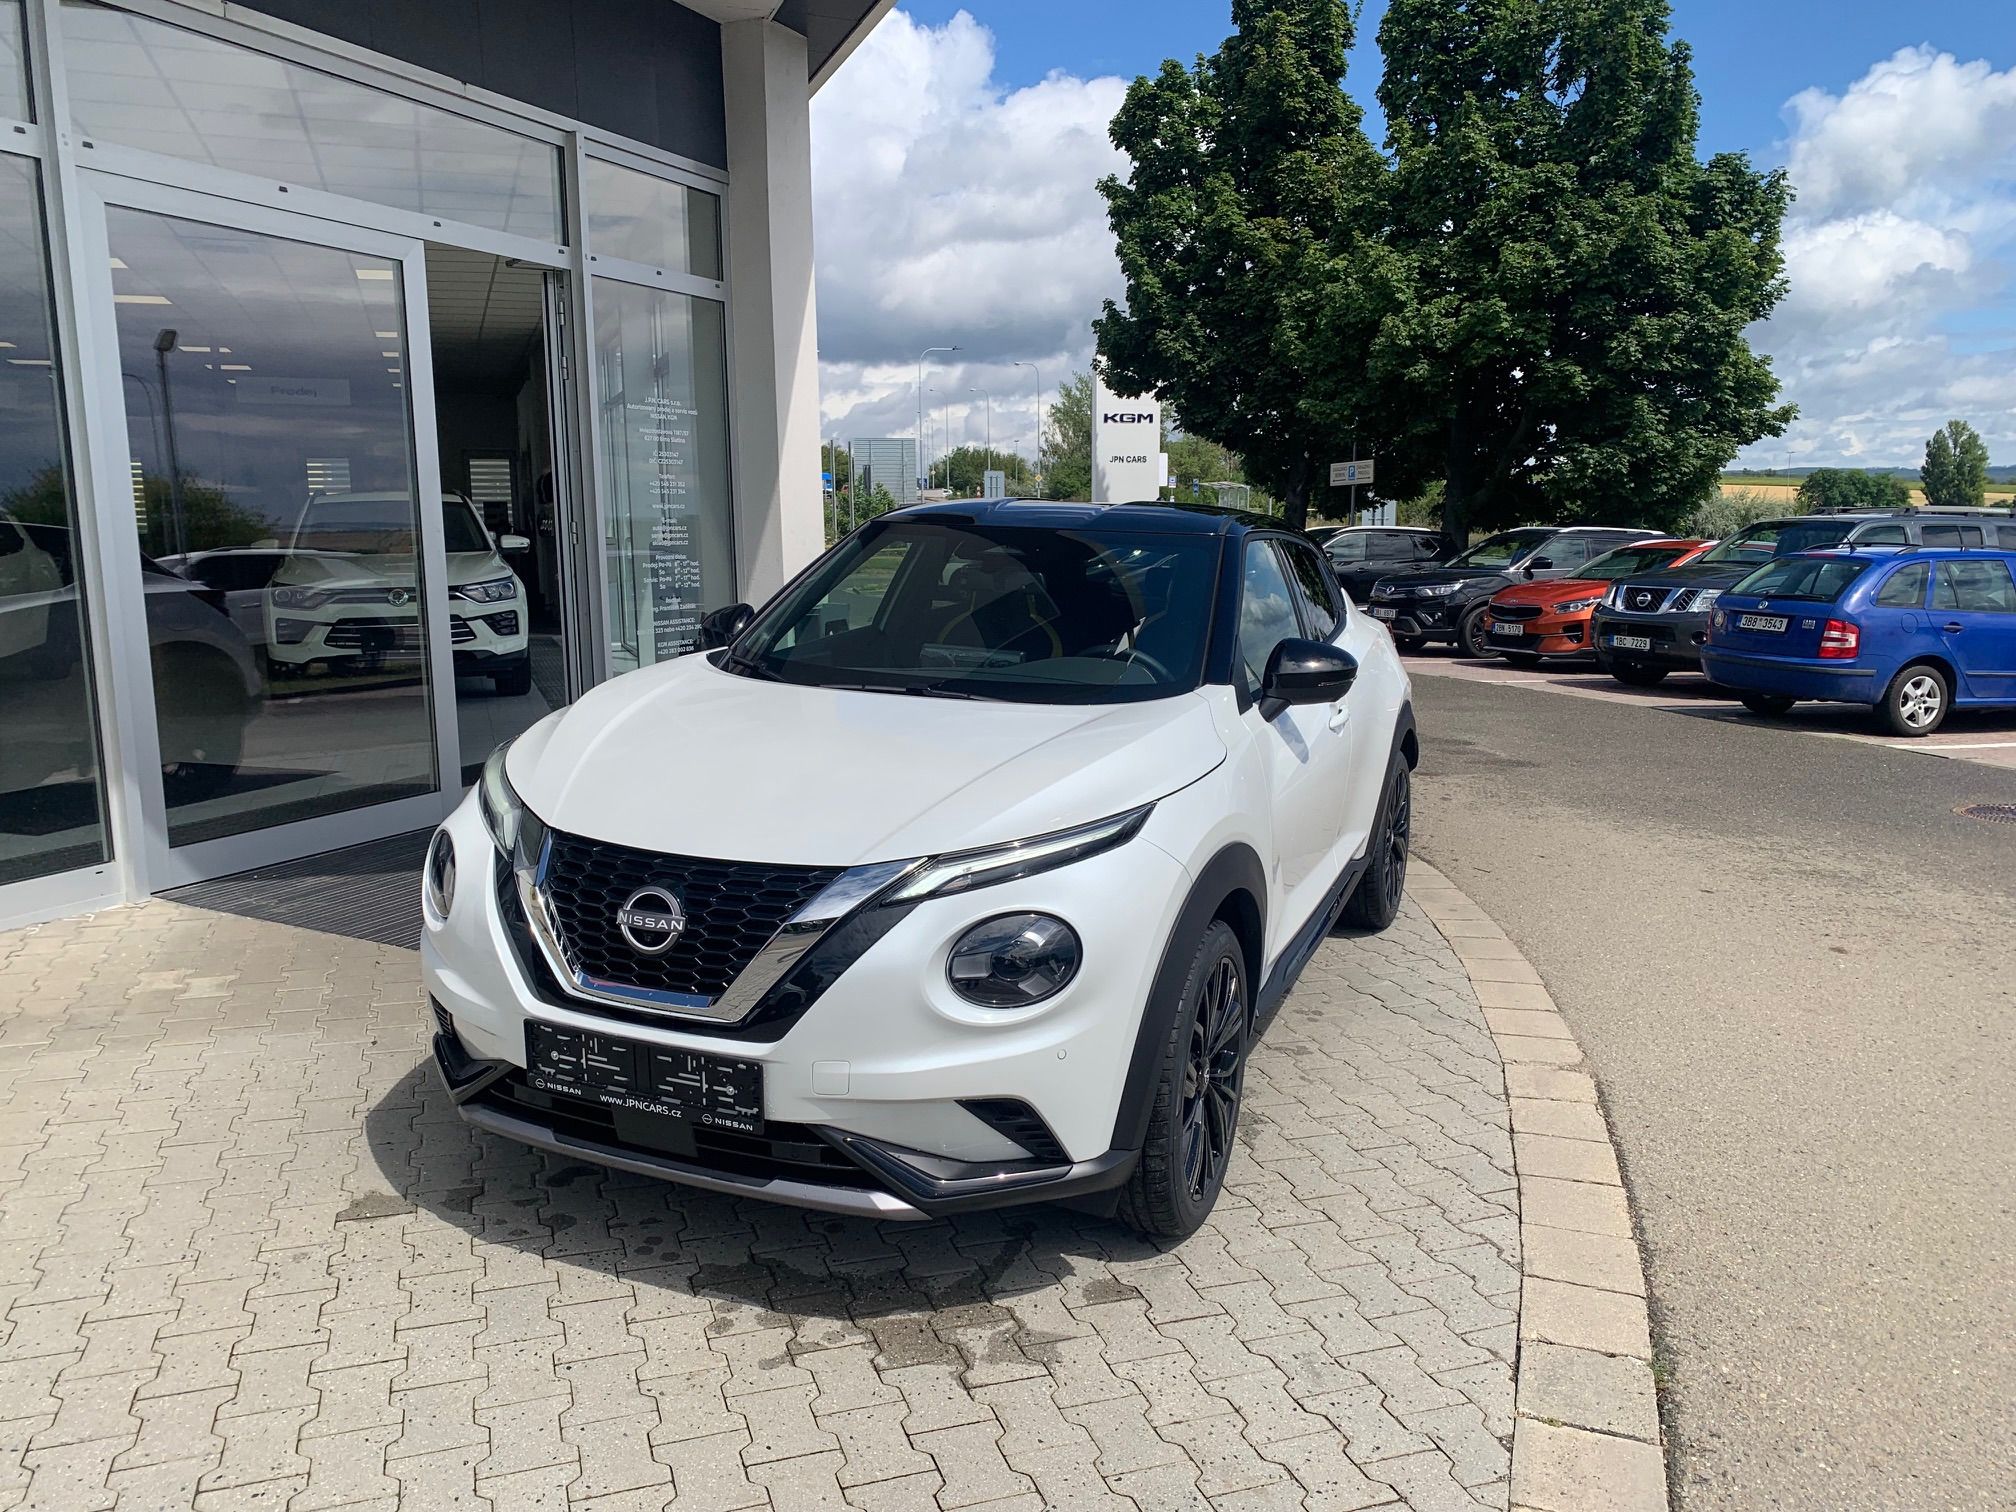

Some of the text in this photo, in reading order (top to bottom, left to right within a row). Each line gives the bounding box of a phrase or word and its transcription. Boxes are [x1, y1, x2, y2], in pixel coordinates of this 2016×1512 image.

[1103, 413, 1153, 424] KGM
[1741, 616, 1783, 630] 3B8 3543
[1631, 638, 1647, 648] 7229
[618, 910, 684, 931] NISSAN
[547, 1082, 582, 1096] NISSAN
[715, 1117, 753, 1131] NISSAN
